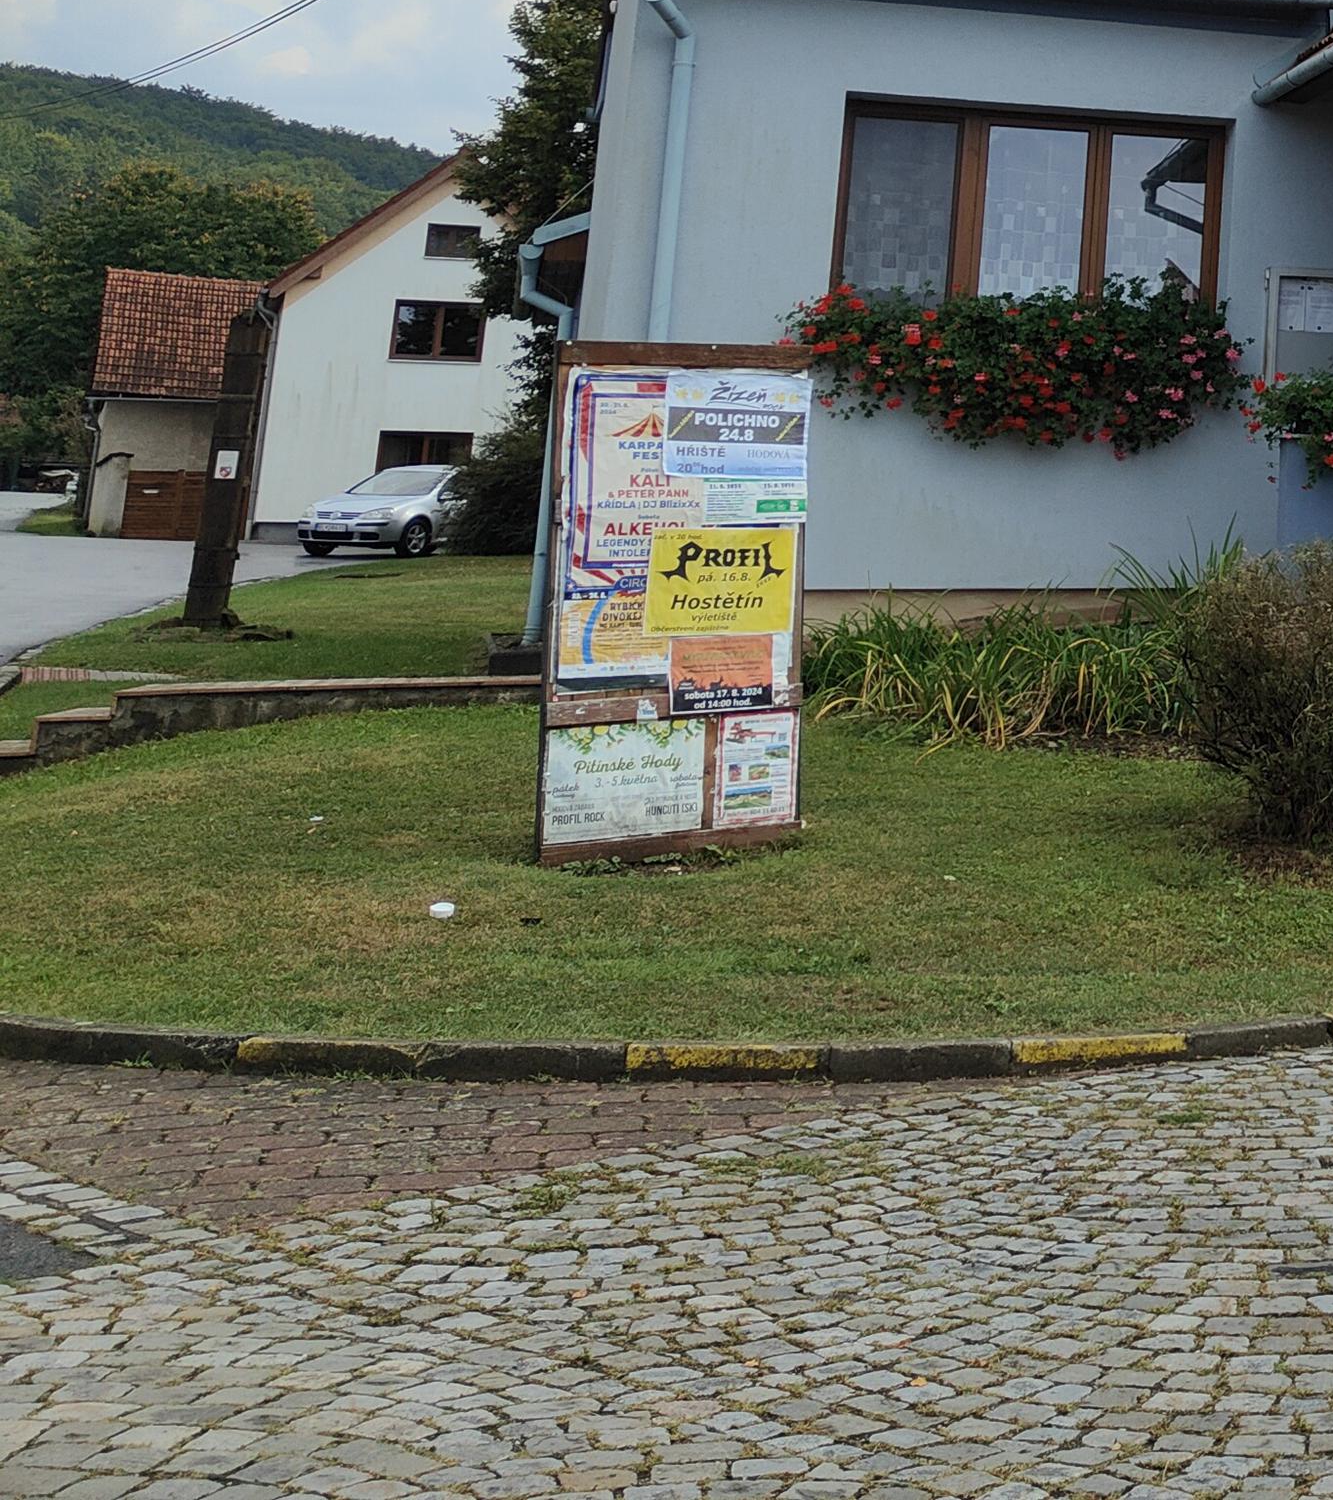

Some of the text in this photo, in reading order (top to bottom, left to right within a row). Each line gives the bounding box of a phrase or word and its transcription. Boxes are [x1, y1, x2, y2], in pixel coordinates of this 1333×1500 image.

[708, 380, 768, 402] Žízeň
[693, 412, 781, 429] POLICHNO
[718, 429, 755, 442] 24.8
[632, 451, 663, 460] FES
[747, 449, 791, 459] HODOVÁ
[617, 489, 655, 498] PETER
[657, 489, 689, 498] PANN
[596, 499, 636, 509] KŘÍDLA
[642, 500, 657, 509] DJ
[596, 538, 645, 548] LEGENDY
[697, 571, 752, 585] pá. 16.8.
[670, 591, 764, 610] Hostětín
[691, 612, 738, 624] výletiště
[684, 687, 763, 700] sobota 17. 8. 2024
[693, 698, 753, 710] od 14:00 hod.
[573, 752, 684, 775] Pitínské Hody
[551, 811, 606, 826] PROFIL ROCK
